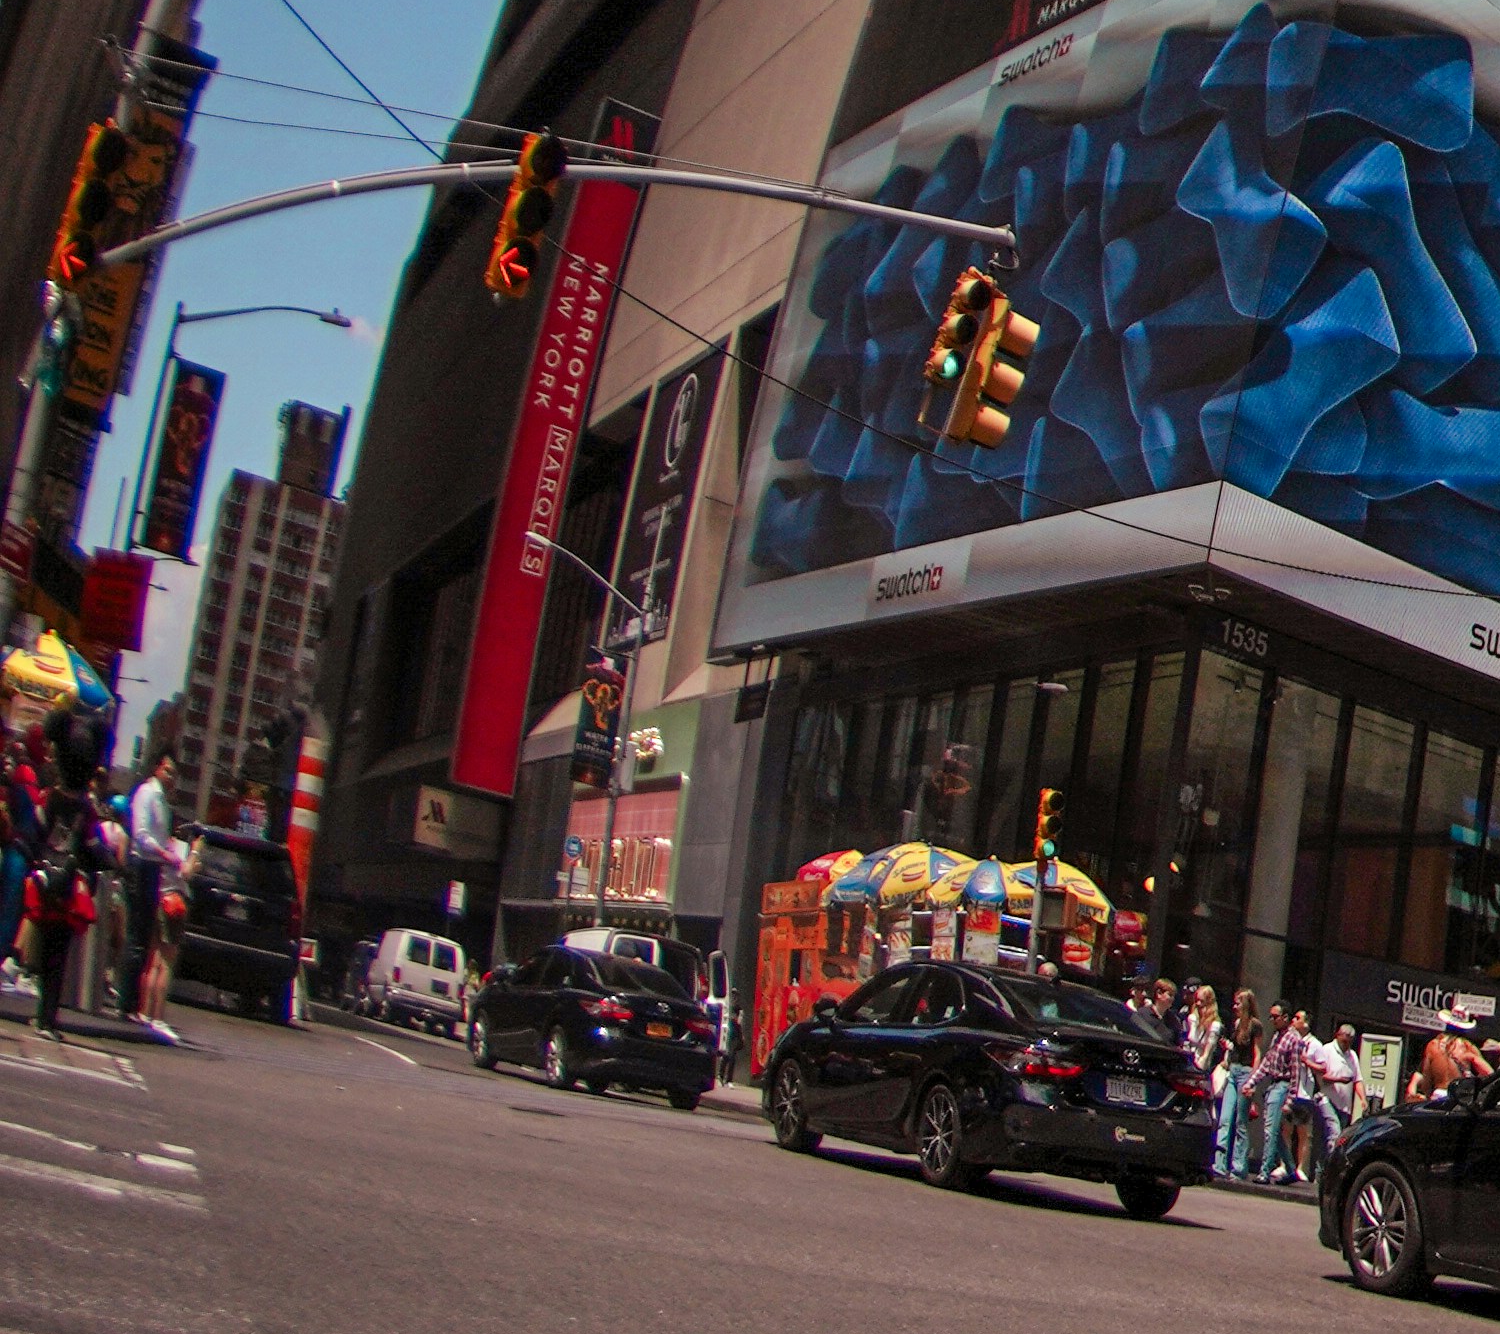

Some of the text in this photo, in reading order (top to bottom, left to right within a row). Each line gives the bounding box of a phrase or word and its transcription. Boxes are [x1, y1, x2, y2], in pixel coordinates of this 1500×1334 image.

[999, 36, 1063, 86] swatch
[533, 254, 586, 409] NEW YORK
[558, 261, 610, 422] MARRIOTT
[875, 564, 932, 602] swatch
[1222, 618, 1269, 658] 1535
